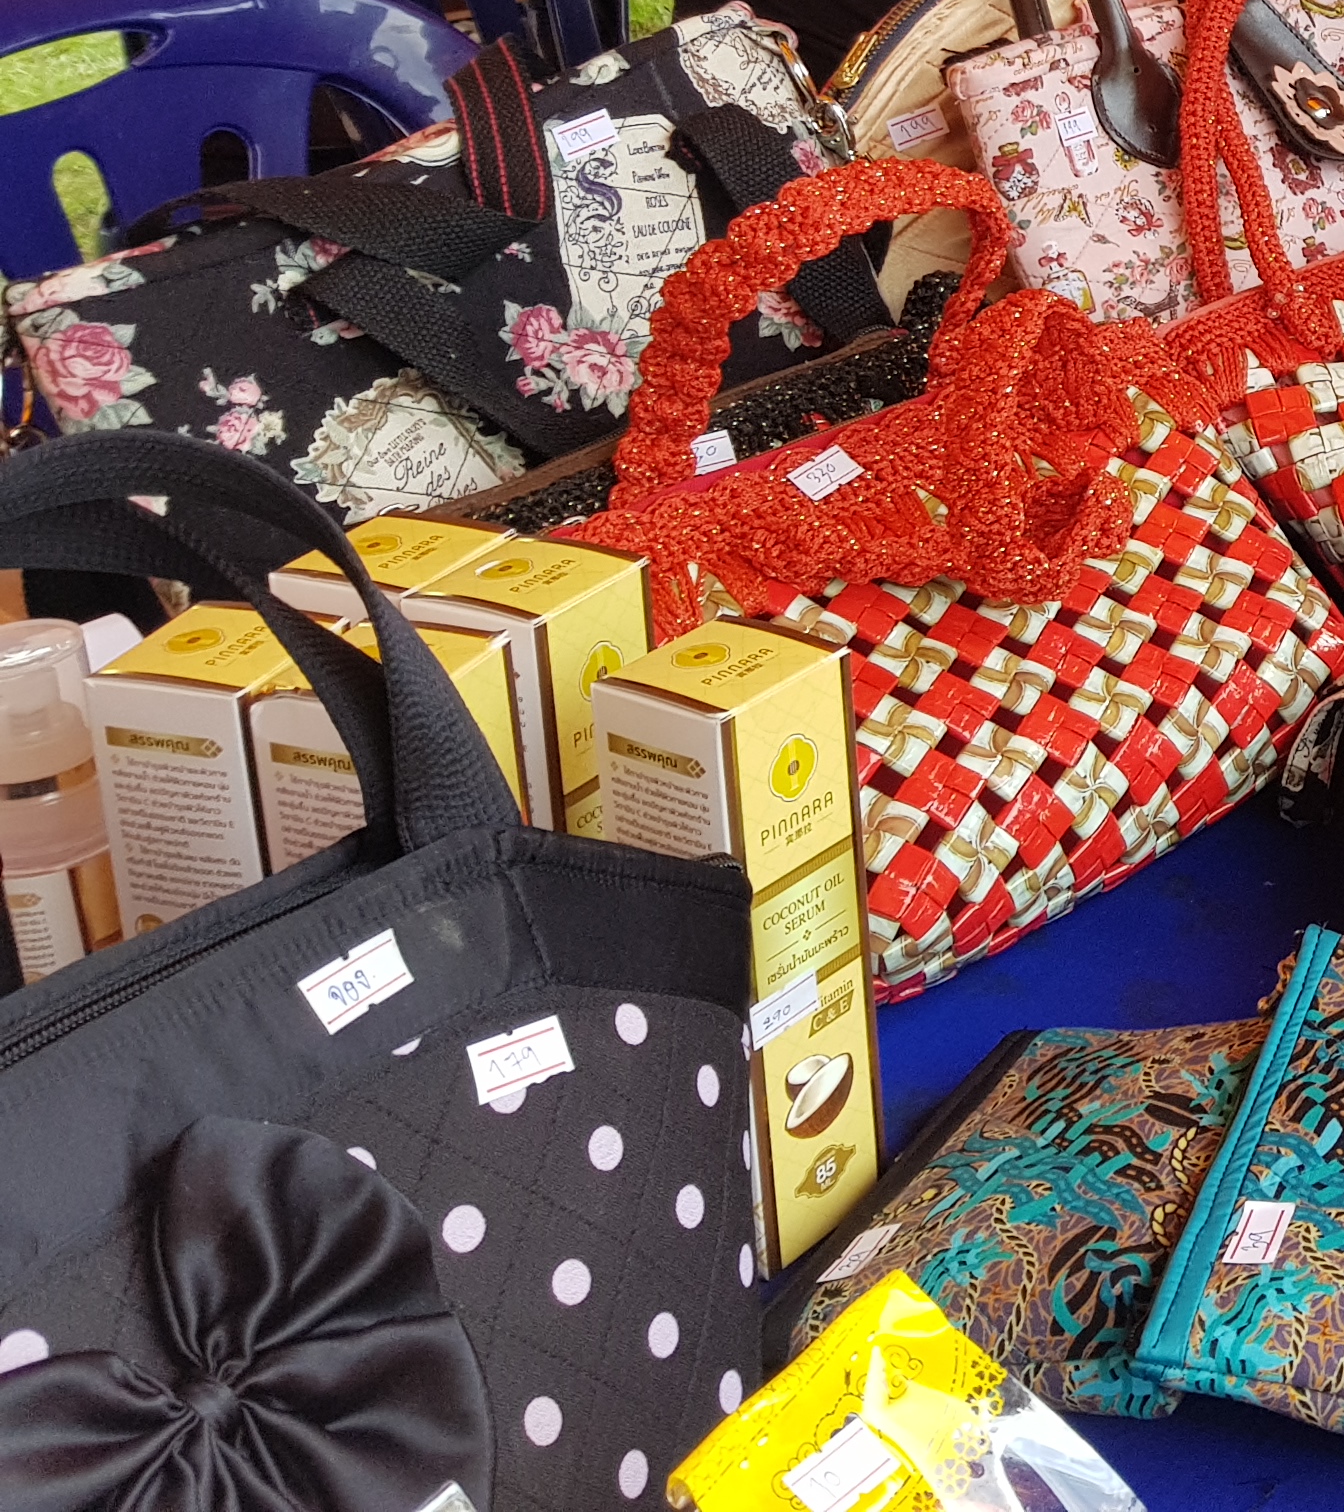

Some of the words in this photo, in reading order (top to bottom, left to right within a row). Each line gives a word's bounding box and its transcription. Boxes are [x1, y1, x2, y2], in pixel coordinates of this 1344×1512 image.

[561, 127, 593, 149] 199
[899, 115, 937, 138] 199
[393, 441, 448, 492] Reine
[425, 466, 452, 497] des
[377, 533, 445, 571] PINNARA
[508, 558, 577, 595] PINNARA
[699, 646, 775, 688] PINNARA
[128, 733, 190, 754] สรรพคุณ
[626, 744, 679, 769] สรรพคุณ
[291, 751, 352, 773] สรรพคุณ
[759, 790, 836, 848] PINNARA
[762, 884, 824, 932] COCONUT
[823, 872, 846, 893] OIL
[783, 899, 826, 936] SERUM
[766, 924, 850, 986] เซรั่มน้ำมันมะพร้าว
[812, 1014, 825, 1032] C
[826, 1006, 837, 1023] &
[838, 996, 851, 1014] E
[488, 1045, 542, 1080] 179
[815, 1156, 838, 1185] 85
